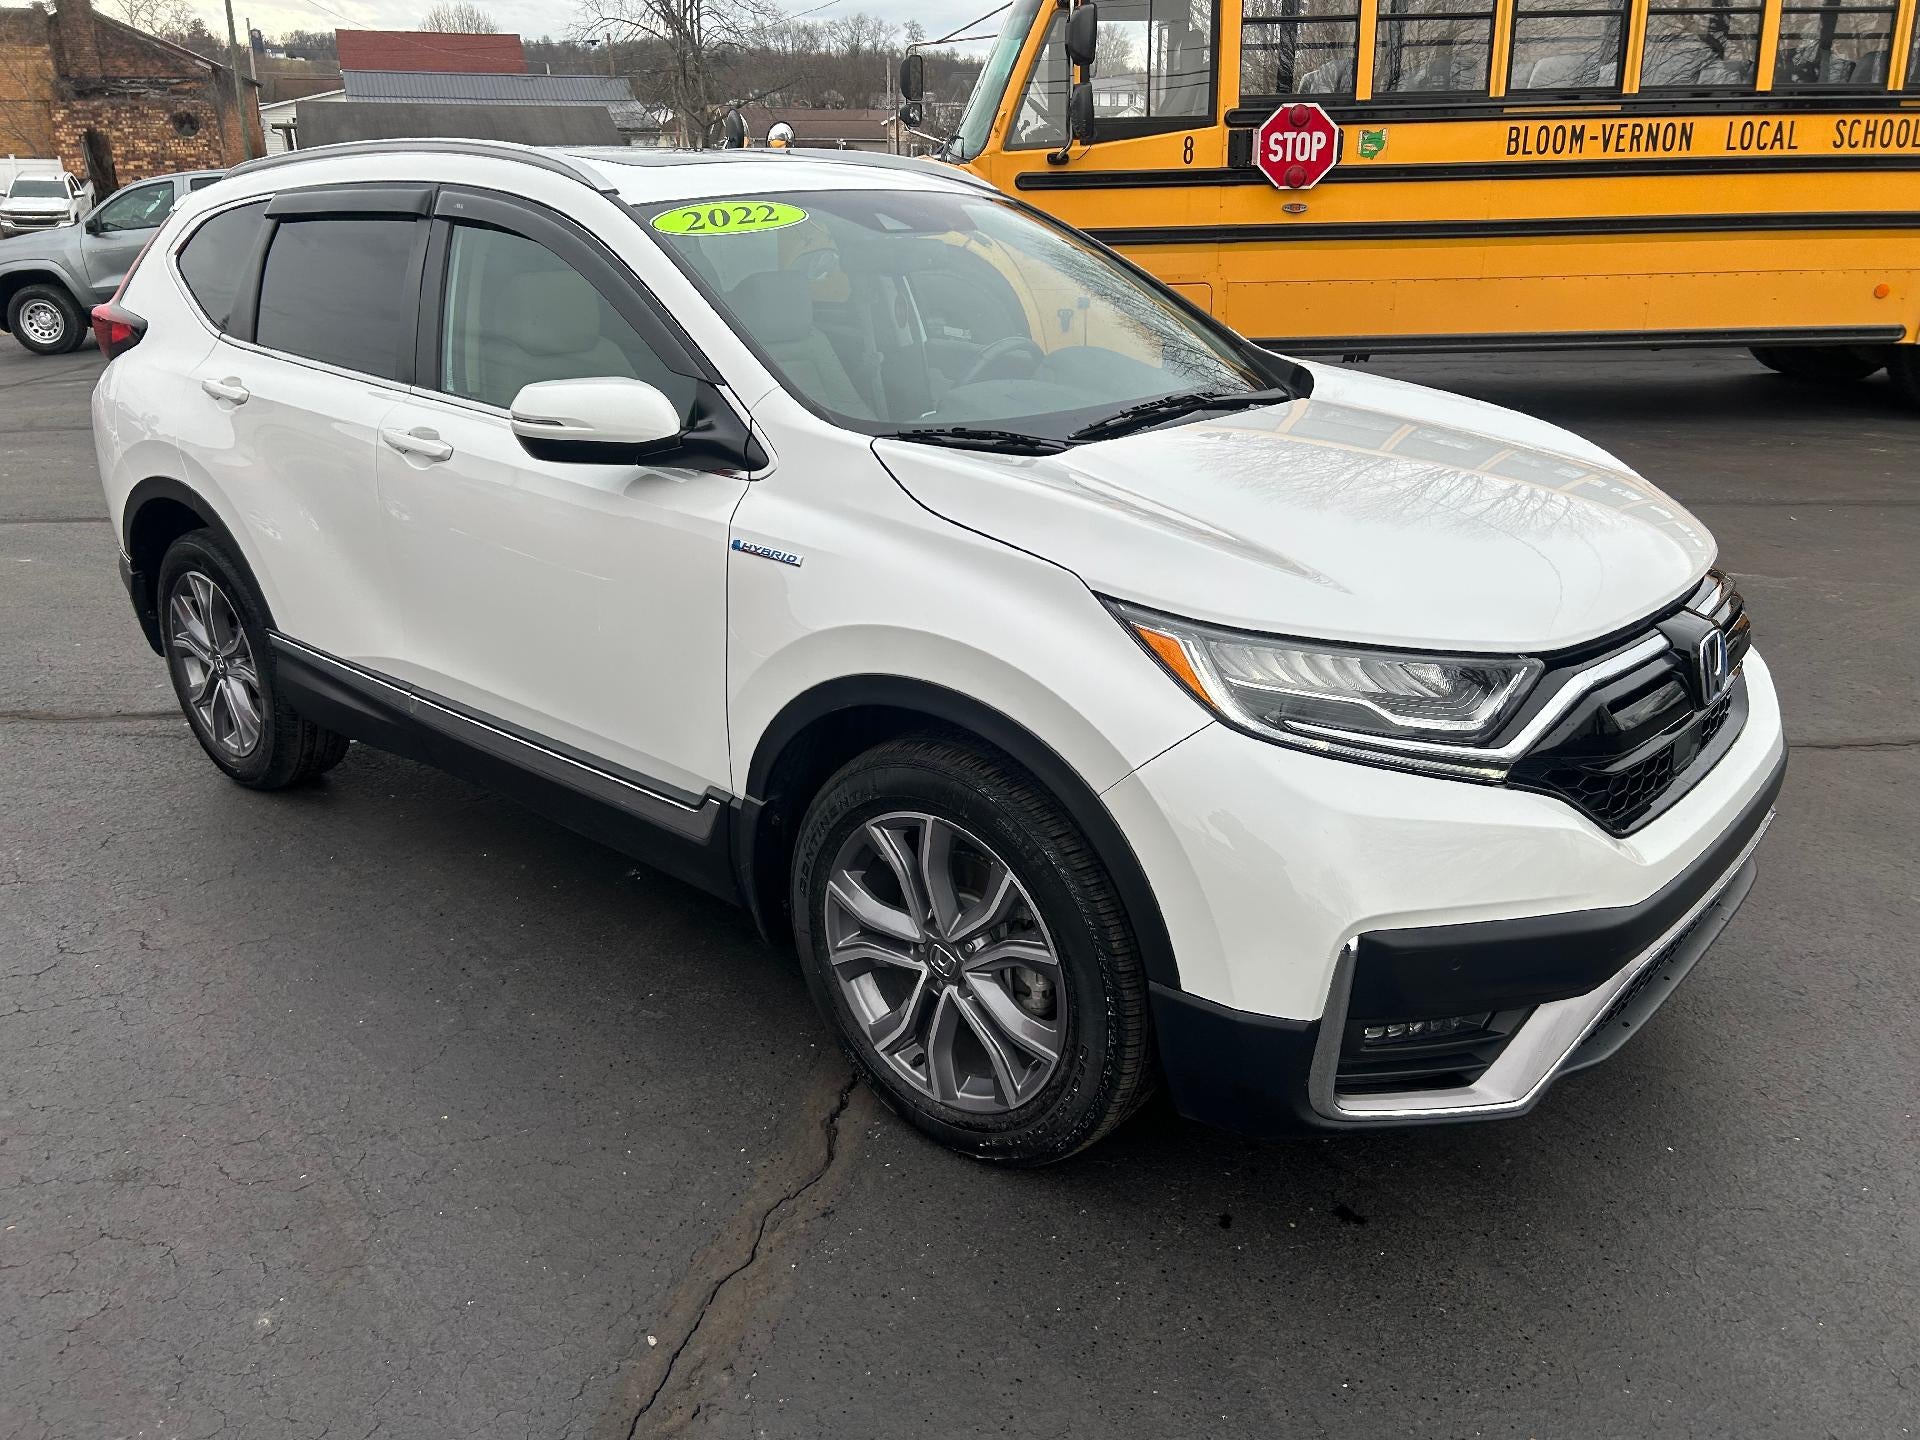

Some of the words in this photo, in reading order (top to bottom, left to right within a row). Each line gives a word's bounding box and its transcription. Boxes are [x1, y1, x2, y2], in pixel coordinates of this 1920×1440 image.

[1183, 135, 1194, 164] 8
[1268, 131, 1327, 162] STOP
[1506, 121, 1694, 156] BLOOM-VERNON
[1726, 120, 1798, 150] LOCAL
[1832, 118, 1920, 149] SCHOOL
[682, 204, 779, 231] 2022
[740, 542, 798, 563] HYBRID
